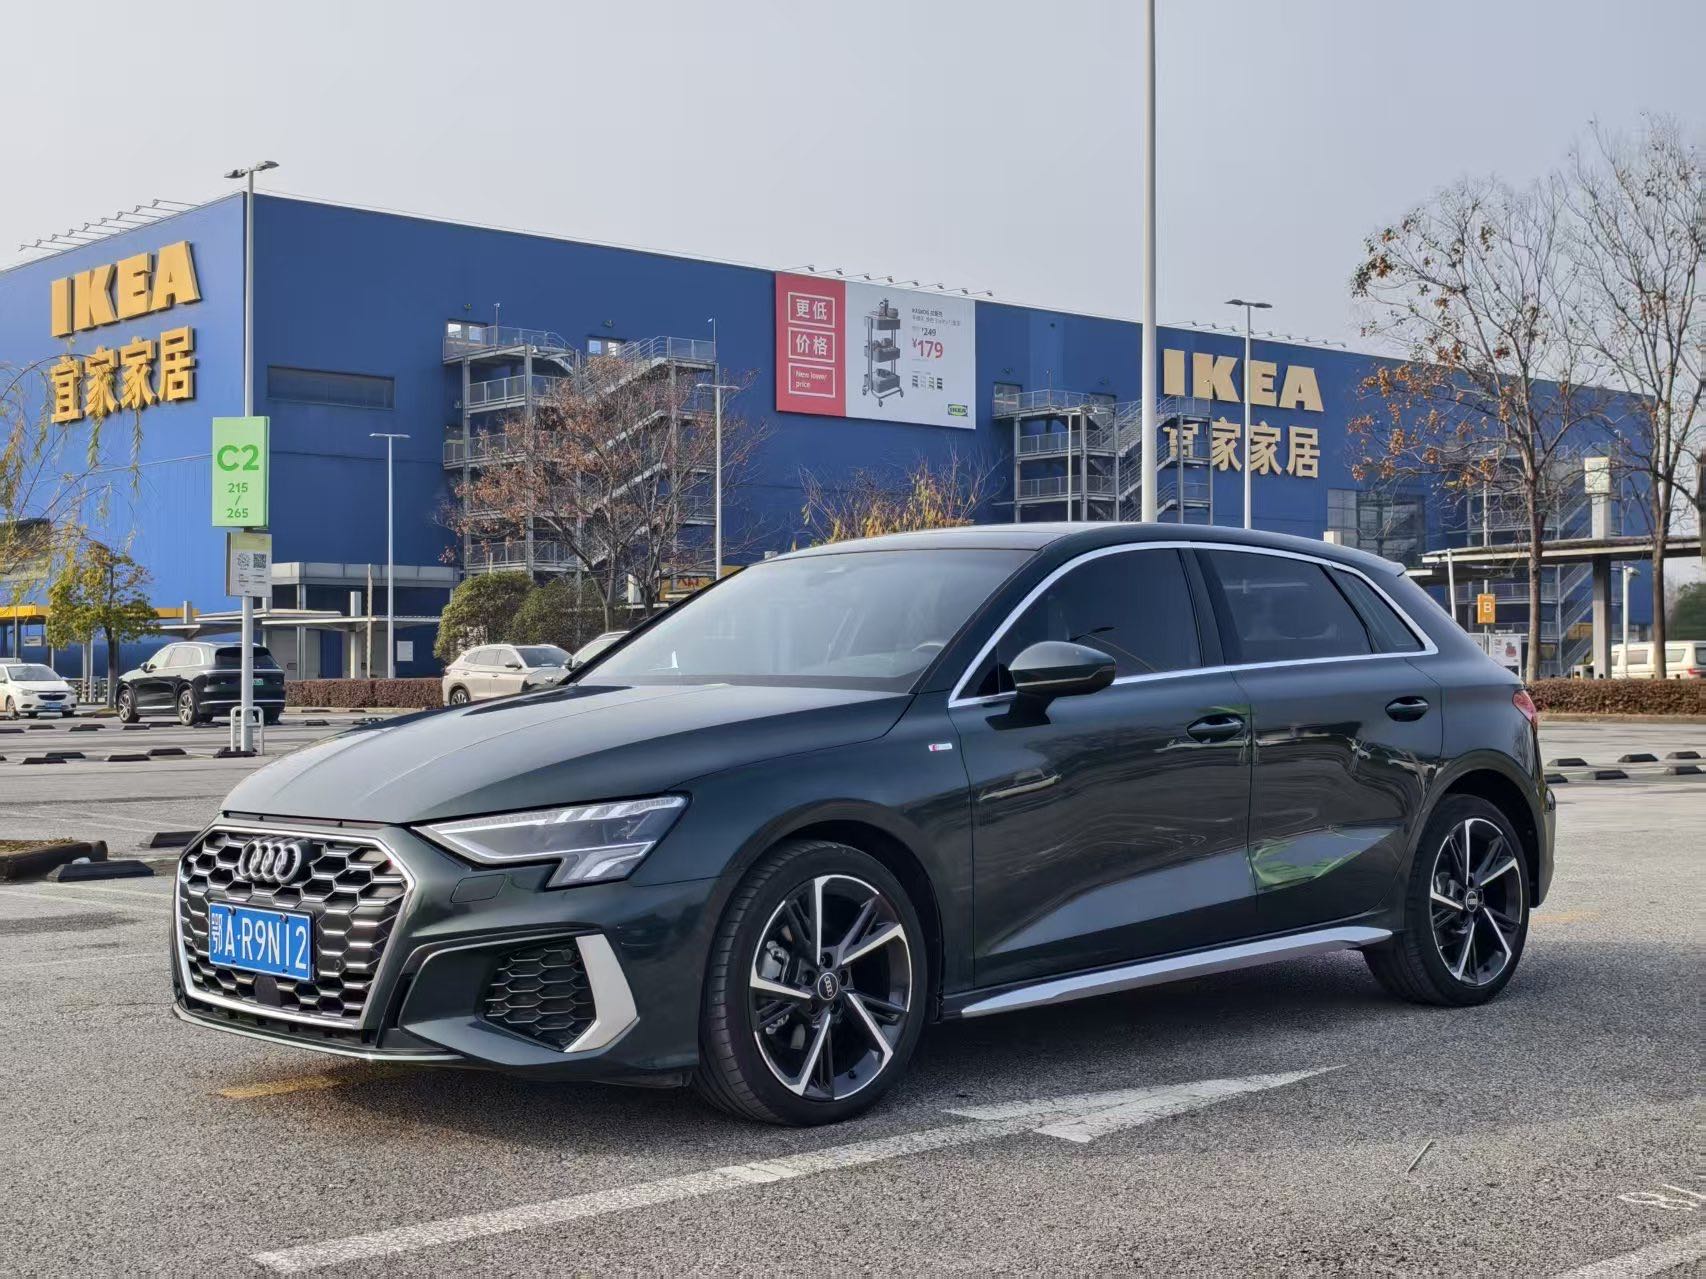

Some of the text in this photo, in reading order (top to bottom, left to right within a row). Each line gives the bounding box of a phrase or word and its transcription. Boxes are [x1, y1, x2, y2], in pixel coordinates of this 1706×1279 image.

[50, 240, 202, 338] IKEA
[796, 298, 828, 321] 更低
[795, 333, 828, 355] 价格
[912, 337, 943, 359] ¥179
[50, 325, 197, 424] 宜家家居
[796, 381, 811, 389] price
[810, 371, 828, 382] lower
[1163, 348, 1324, 412] IKEA
[216, 444, 260, 472] C2
[228, 483, 249, 494] 215
[226, 508, 249, 519] 265
[1484, 602, 1492, 612] B
